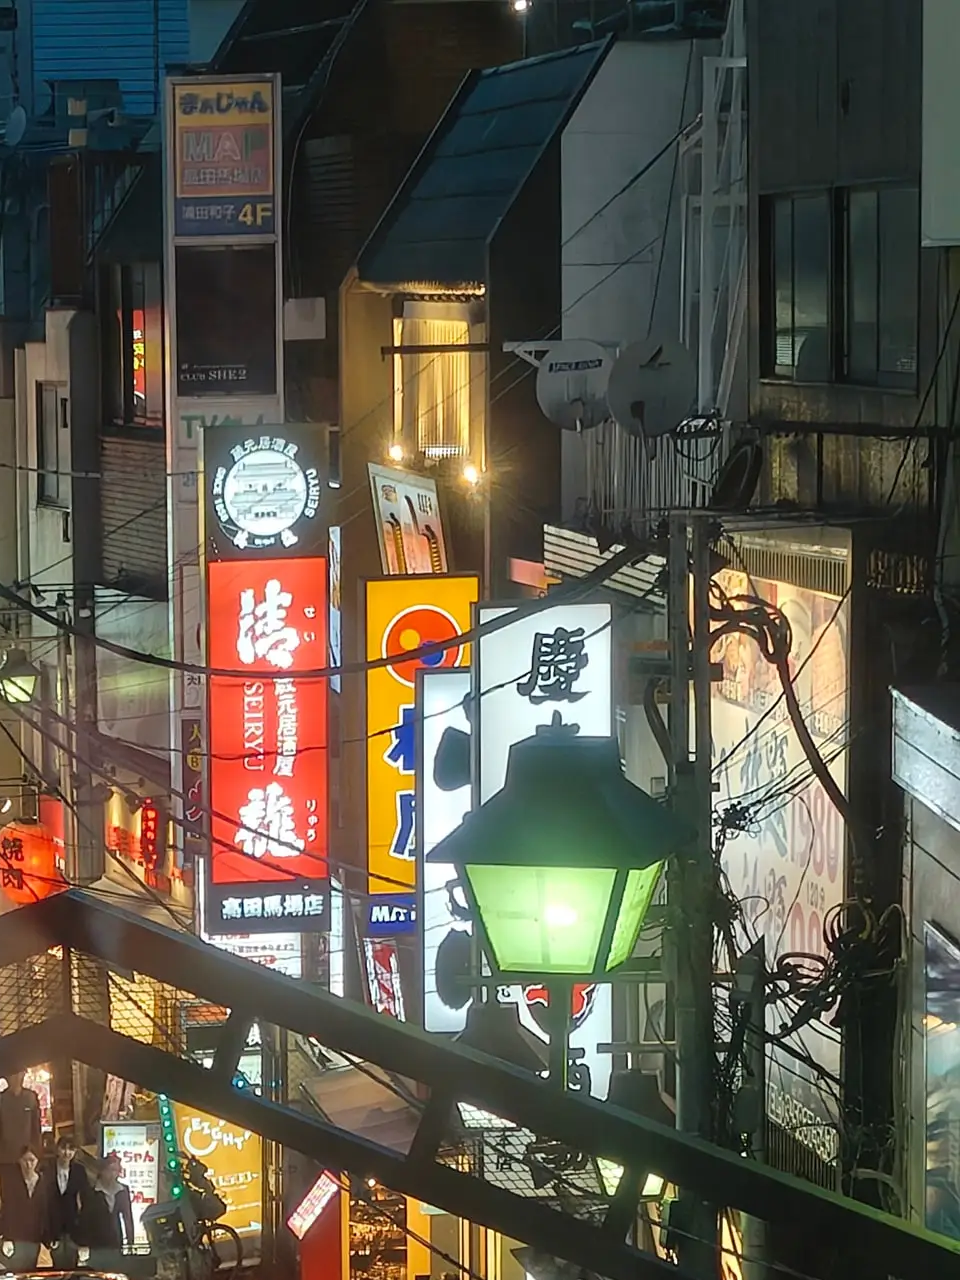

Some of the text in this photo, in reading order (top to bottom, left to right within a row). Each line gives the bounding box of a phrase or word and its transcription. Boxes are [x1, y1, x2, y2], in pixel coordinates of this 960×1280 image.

[238, 203, 272, 226] 4F
[303, 468, 320, 518] SEIRYU
[303, 605, 317, 642] せい
[243, 680, 265, 772] SEIRYU
[222, 895, 324, 919] 高田馬場店
